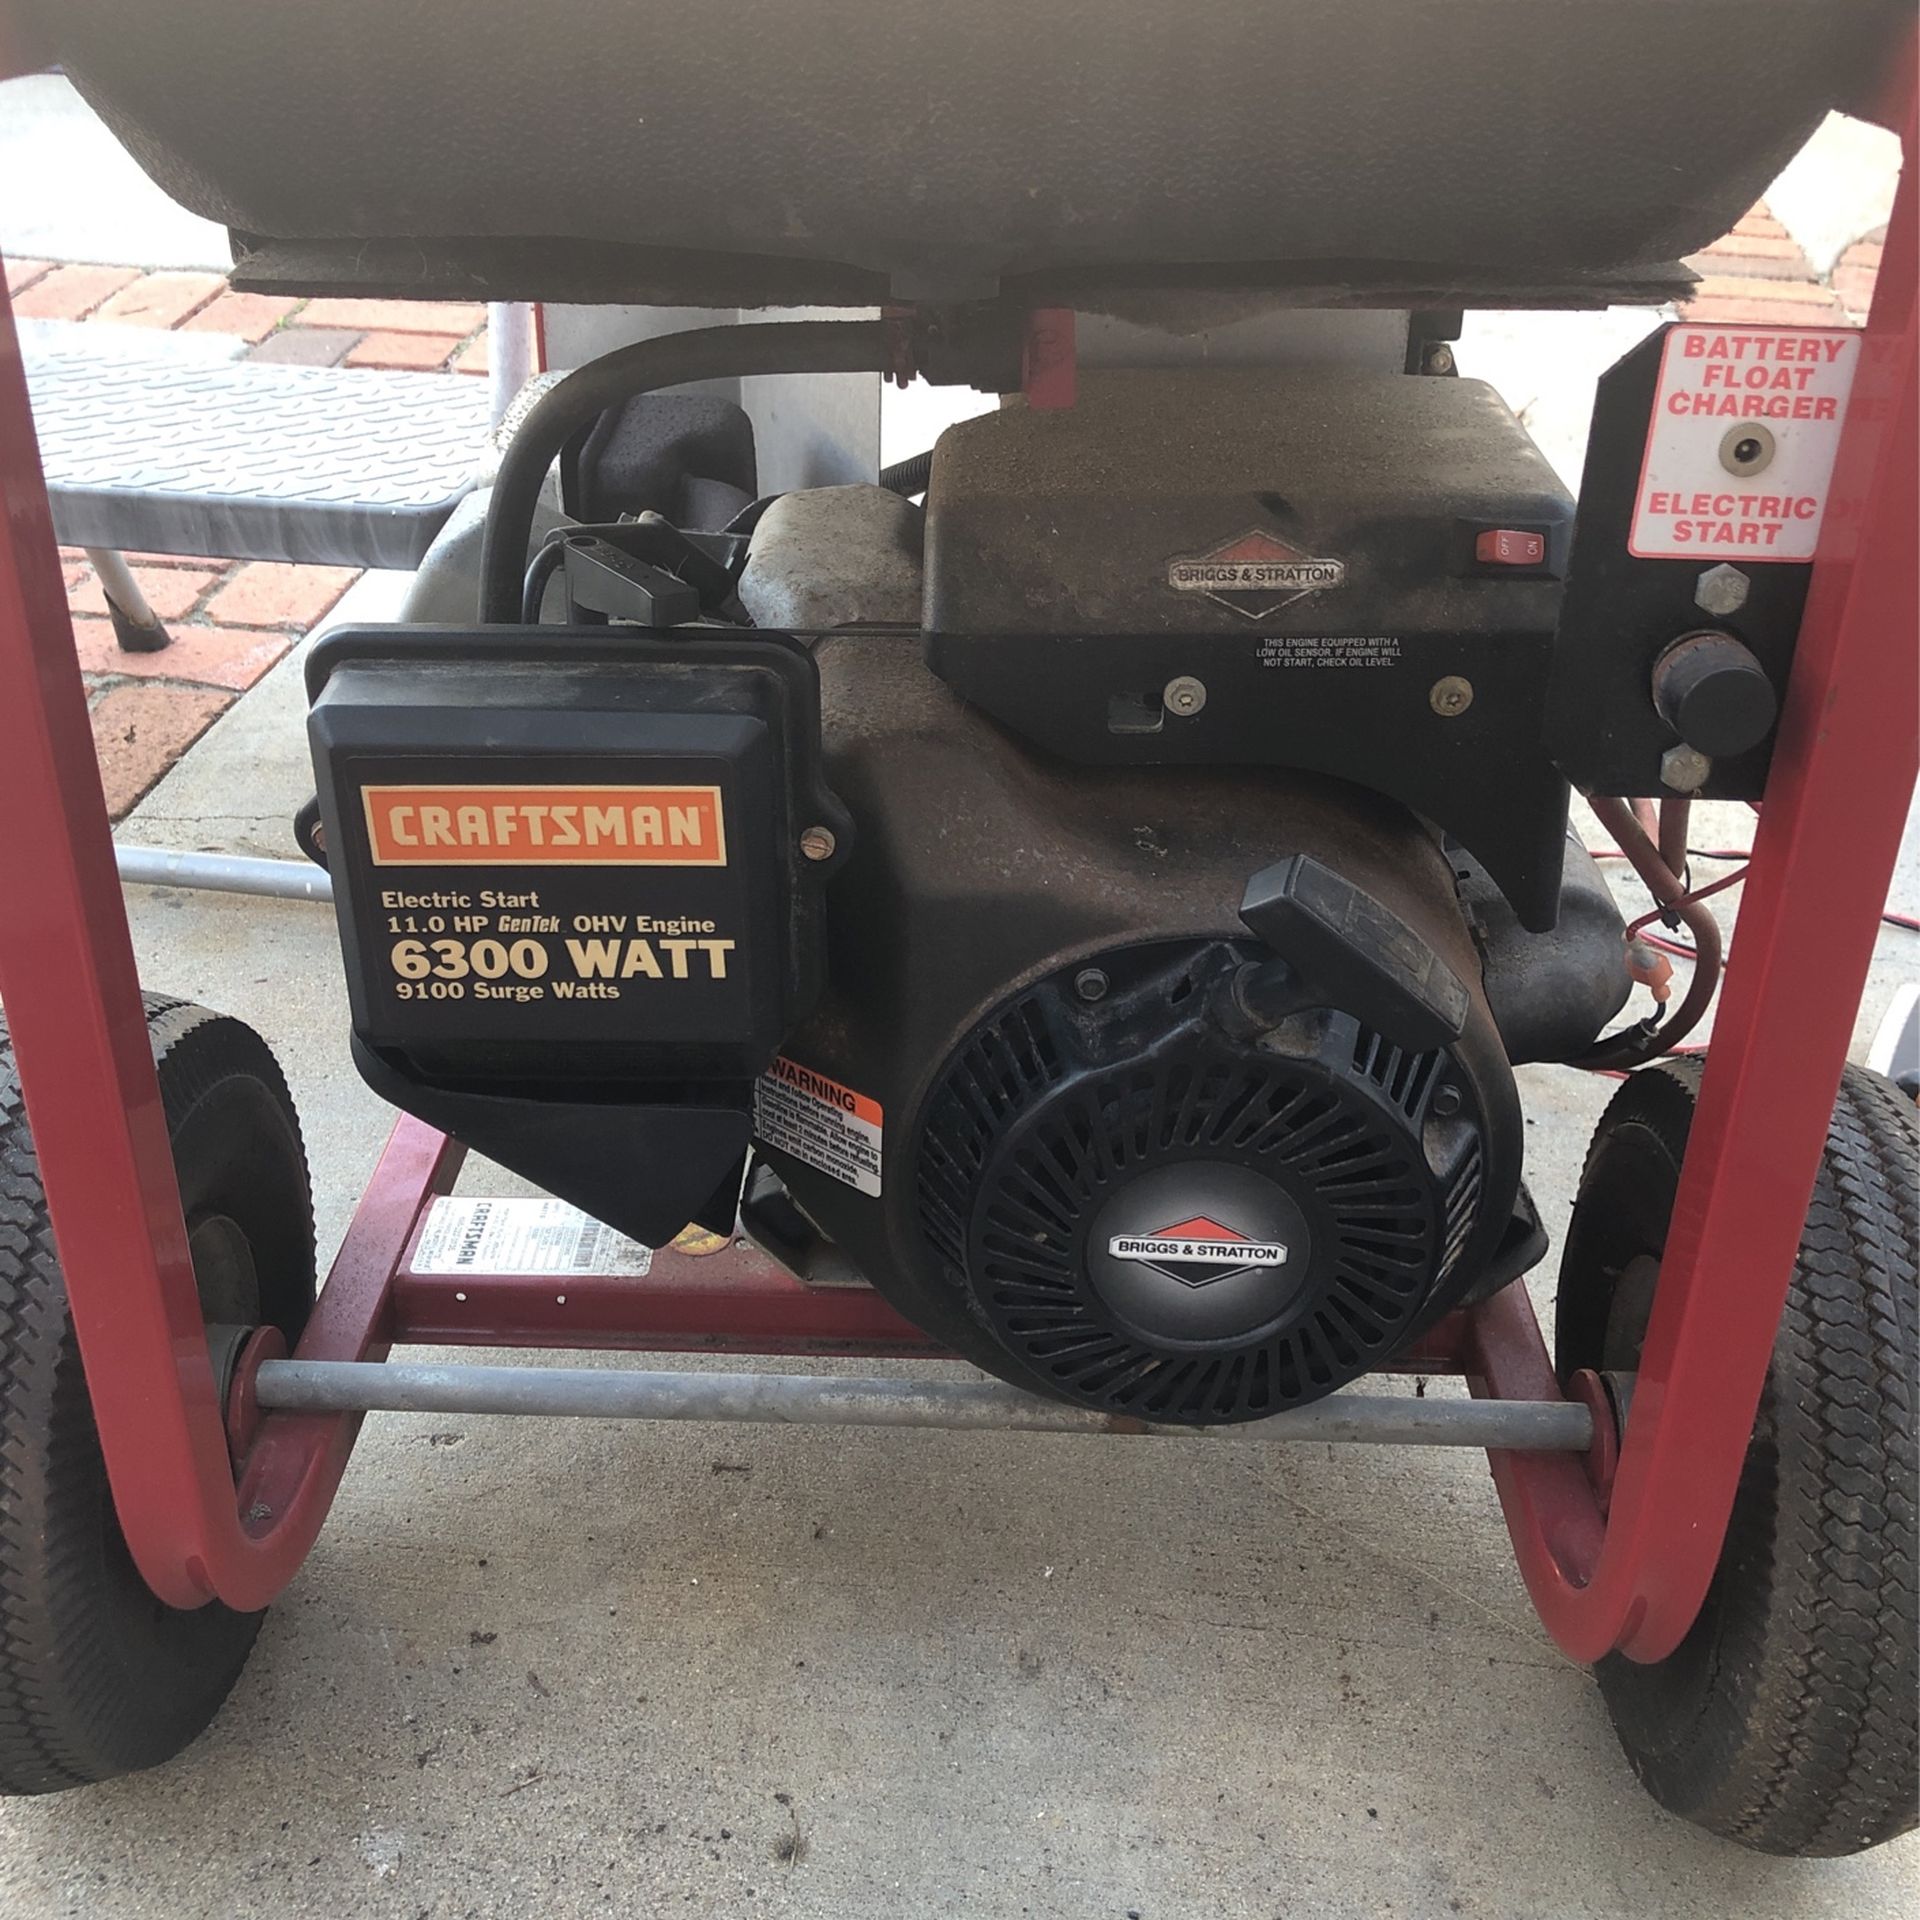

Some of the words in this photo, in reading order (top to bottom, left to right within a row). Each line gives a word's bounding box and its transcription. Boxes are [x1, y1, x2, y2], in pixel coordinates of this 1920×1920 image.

[1684, 335, 1846, 363] BATTERY
[1703, 365, 1815, 391] FLOAT
[1667, 392, 1838, 420] CHARGER
[1648, 493, 1818, 519] ELECTRIC
[1672, 520, 1783, 545] START
[1500, 535, 1509, 556] OFF
[1527, 540, 1538, 556] ON
[1178, 568, 1238, 582] BRIGGS
[1241, 568, 1251, 581] &
[1255, 567, 1335, 581] STRATTON
[1256, 648, 1276, 657] LOW
[1278, 648, 1293, 657] OIL
[1295, 648, 1333, 657] SENSOR.
[1335, 648, 1344, 656] IF
[1346, 648, 1379, 656] ENGINE
[1381, 647, 1402, 656] WILL
[1264, 638, 1284, 647] THIS
[1286, 638, 1319, 647] ENGINE
[1321, 638, 1366, 647] EQUIPPED
[1368, 638, 1390, 646] WITH
[1392, 638, 1399, 646] A
[1263, 658, 1282, 667] NOT
[1283, 658, 1315, 668] START,
[1316, 658, 1348, 667] CHECK
[1349, 658, 1363, 666] OIL
[1365, 658, 1395, 666] LEVEL.
[388, 806, 702, 846] CRAFTSMAN
[382, 891, 472, 908] Electric
[480, 891, 540, 908] Start
[388, 916, 445, 933] 11.0
[454, 916, 489, 933] HP
[498, 915, 560, 933] GenTek
[573, 916, 627, 933] OHV
[636, 916, 716, 937] Engine
[391, 939, 549, 979] 6300
[564, 939, 736, 979] WATT
[395, 982, 465, 999] 9100
[473, 982, 545, 1003] Surge
[551, 982, 620, 999] Watts
[772, 1058, 856, 1114] WARNING
[774, 1135, 790, 1150] NOT
[456, 1203, 492, 1265] CRAFTSMAN
[1118, 1241, 1178, 1255] BRIGGS
[1182, 1245, 1193, 1255] &
[1197, 1246, 1278, 1260] STRATTON
